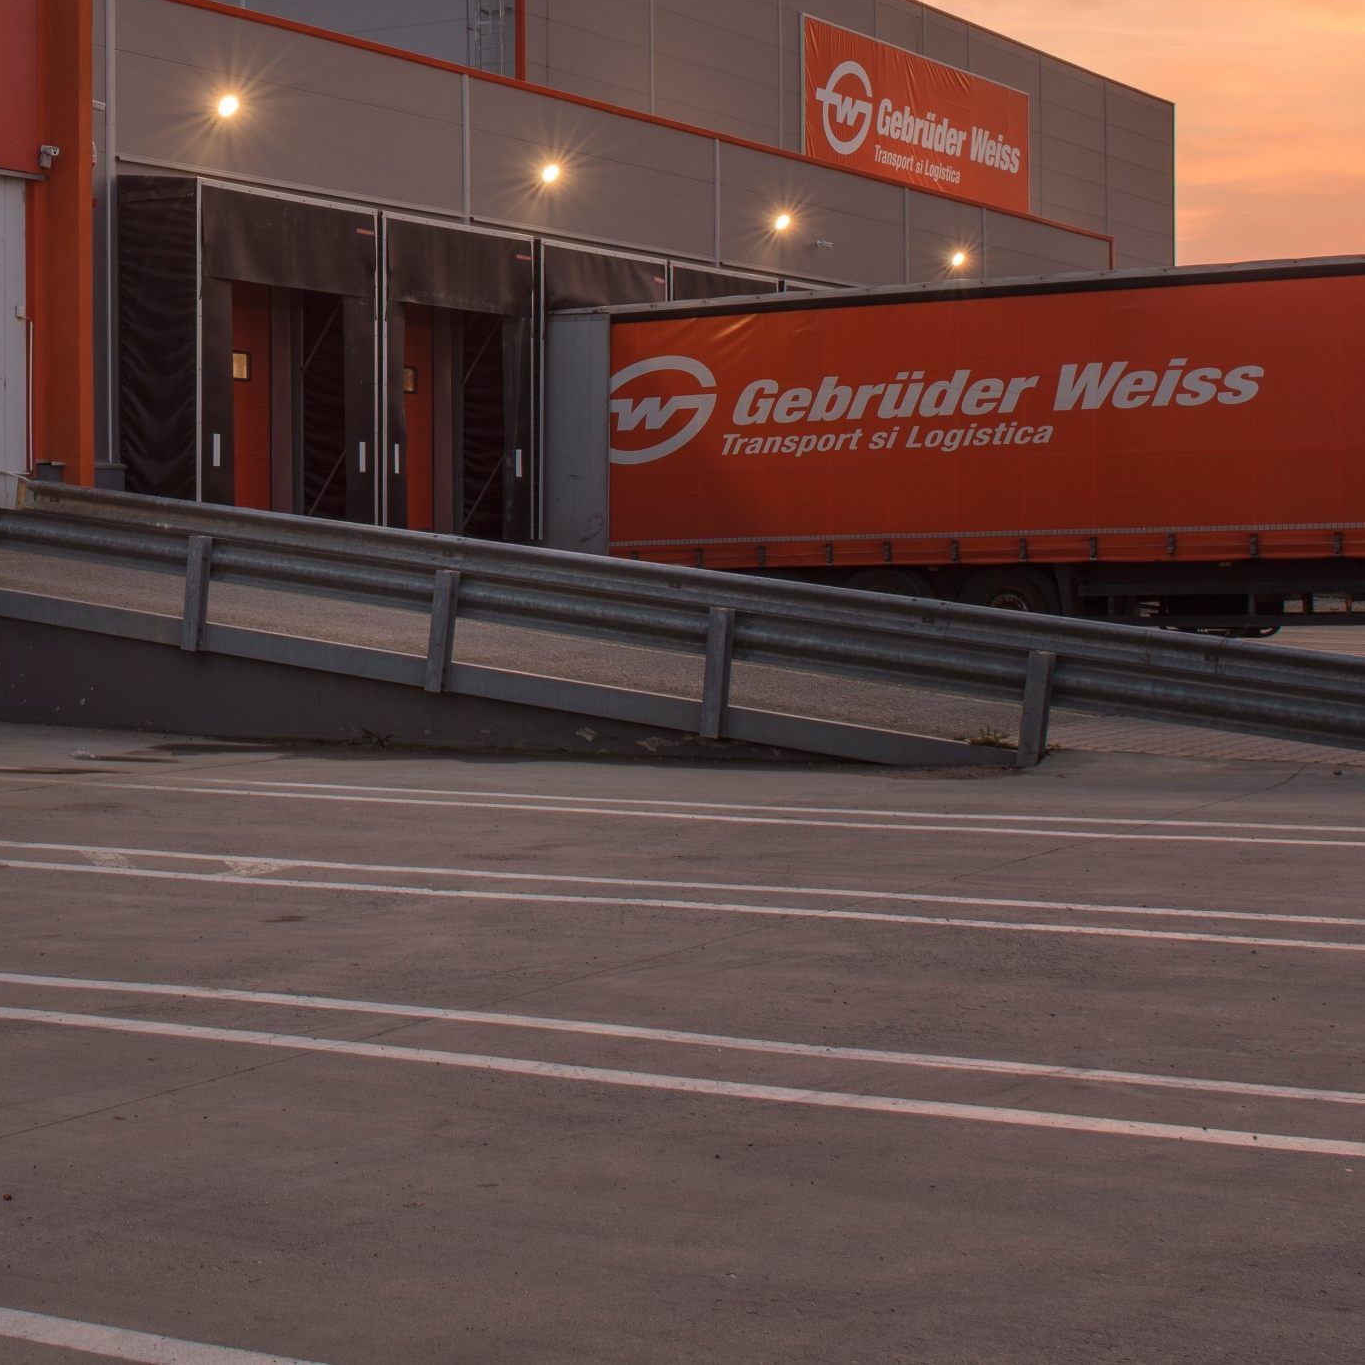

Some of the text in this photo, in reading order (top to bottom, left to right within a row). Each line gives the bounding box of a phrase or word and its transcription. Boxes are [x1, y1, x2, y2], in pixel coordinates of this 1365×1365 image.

[877, 98, 1020, 174] Gebrüder Weiss
[874, 144, 961, 184] Transport si Logistica
[733, 358, 1264, 425] Gebrüder Weiss
[722, 424, 1053, 457] Transport si Logistica
